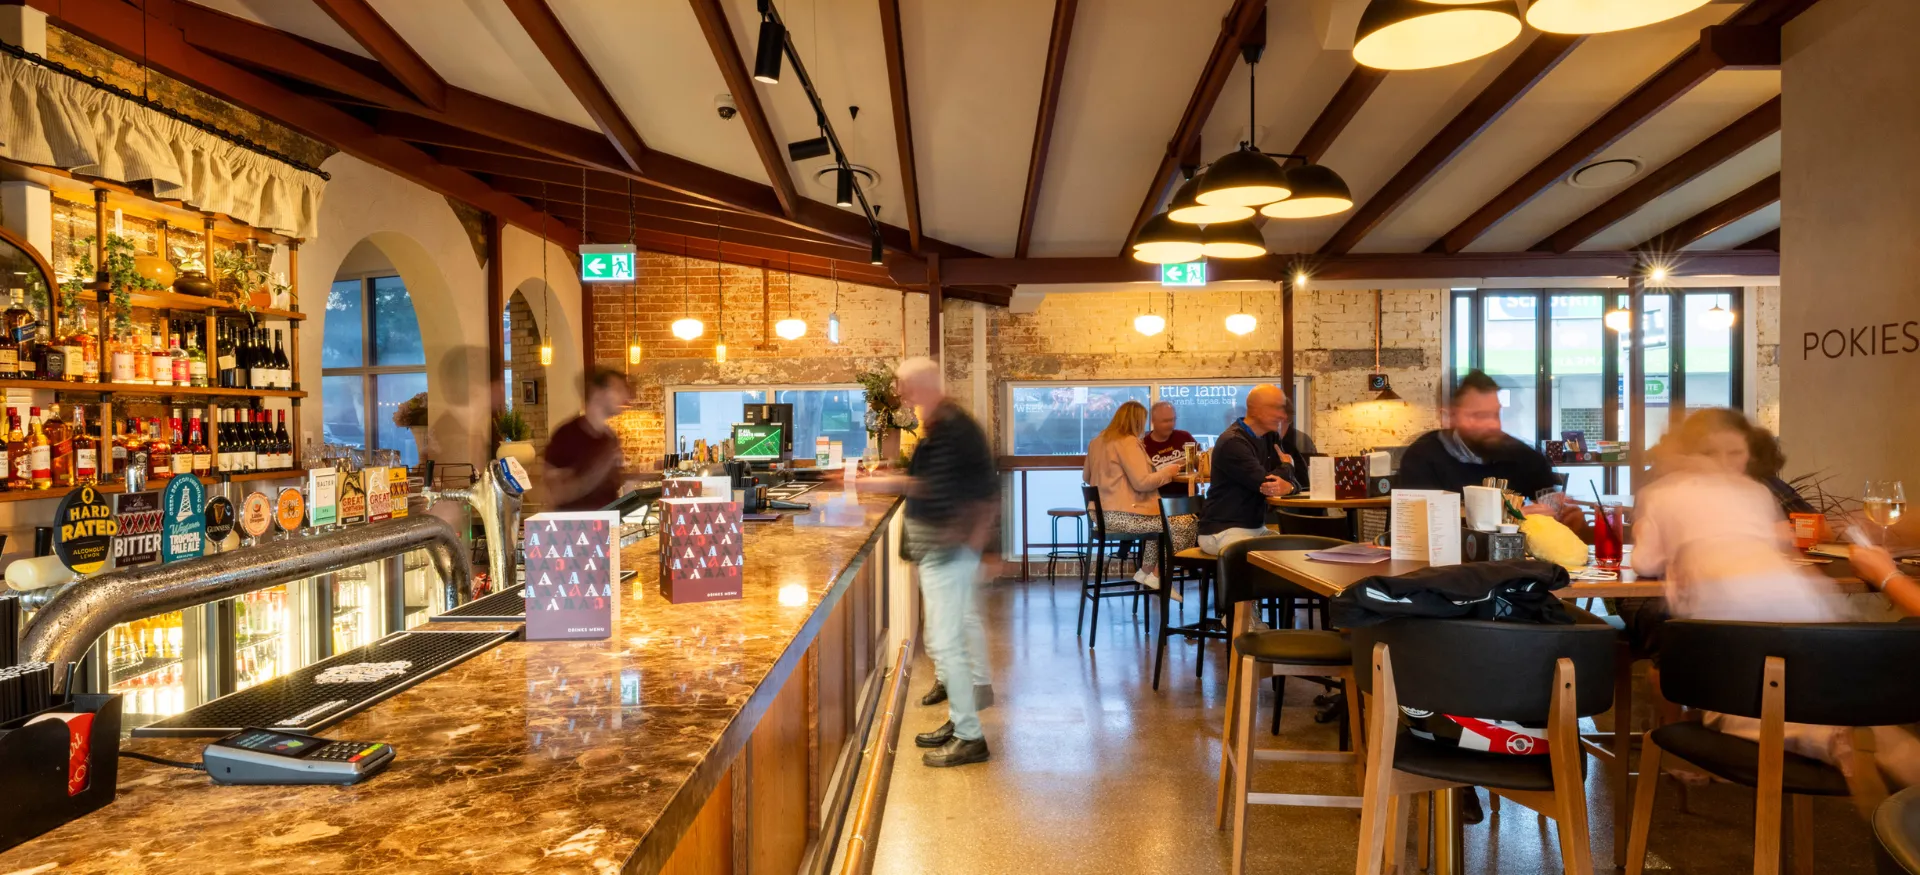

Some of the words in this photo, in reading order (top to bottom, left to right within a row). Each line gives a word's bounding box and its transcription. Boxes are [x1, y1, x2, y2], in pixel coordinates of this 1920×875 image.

[1804, 320, 1920, 361] POKIES
[1160, 386, 1190, 398] ttle
[1195, 386, 1237, 397] lamb
[342, 496, 364, 506] GREAT
[370, 492, 390, 504] GREAT
[70, 505, 110, 521] HARD
[116, 511, 164, 537] XXXX
[207, 524, 231, 533] GUINNESS
[61, 519, 118, 543] RATED
[169, 532, 201, 545] TROPICAL
[73, 546, 105, 555] ALCOHOLIC
[114, 533, 161, 558] BITTER
[170, 543, 187, 555] PALE
[187, 541, 200, 552] ALE
[80, 552, 100, 560] LEMON
